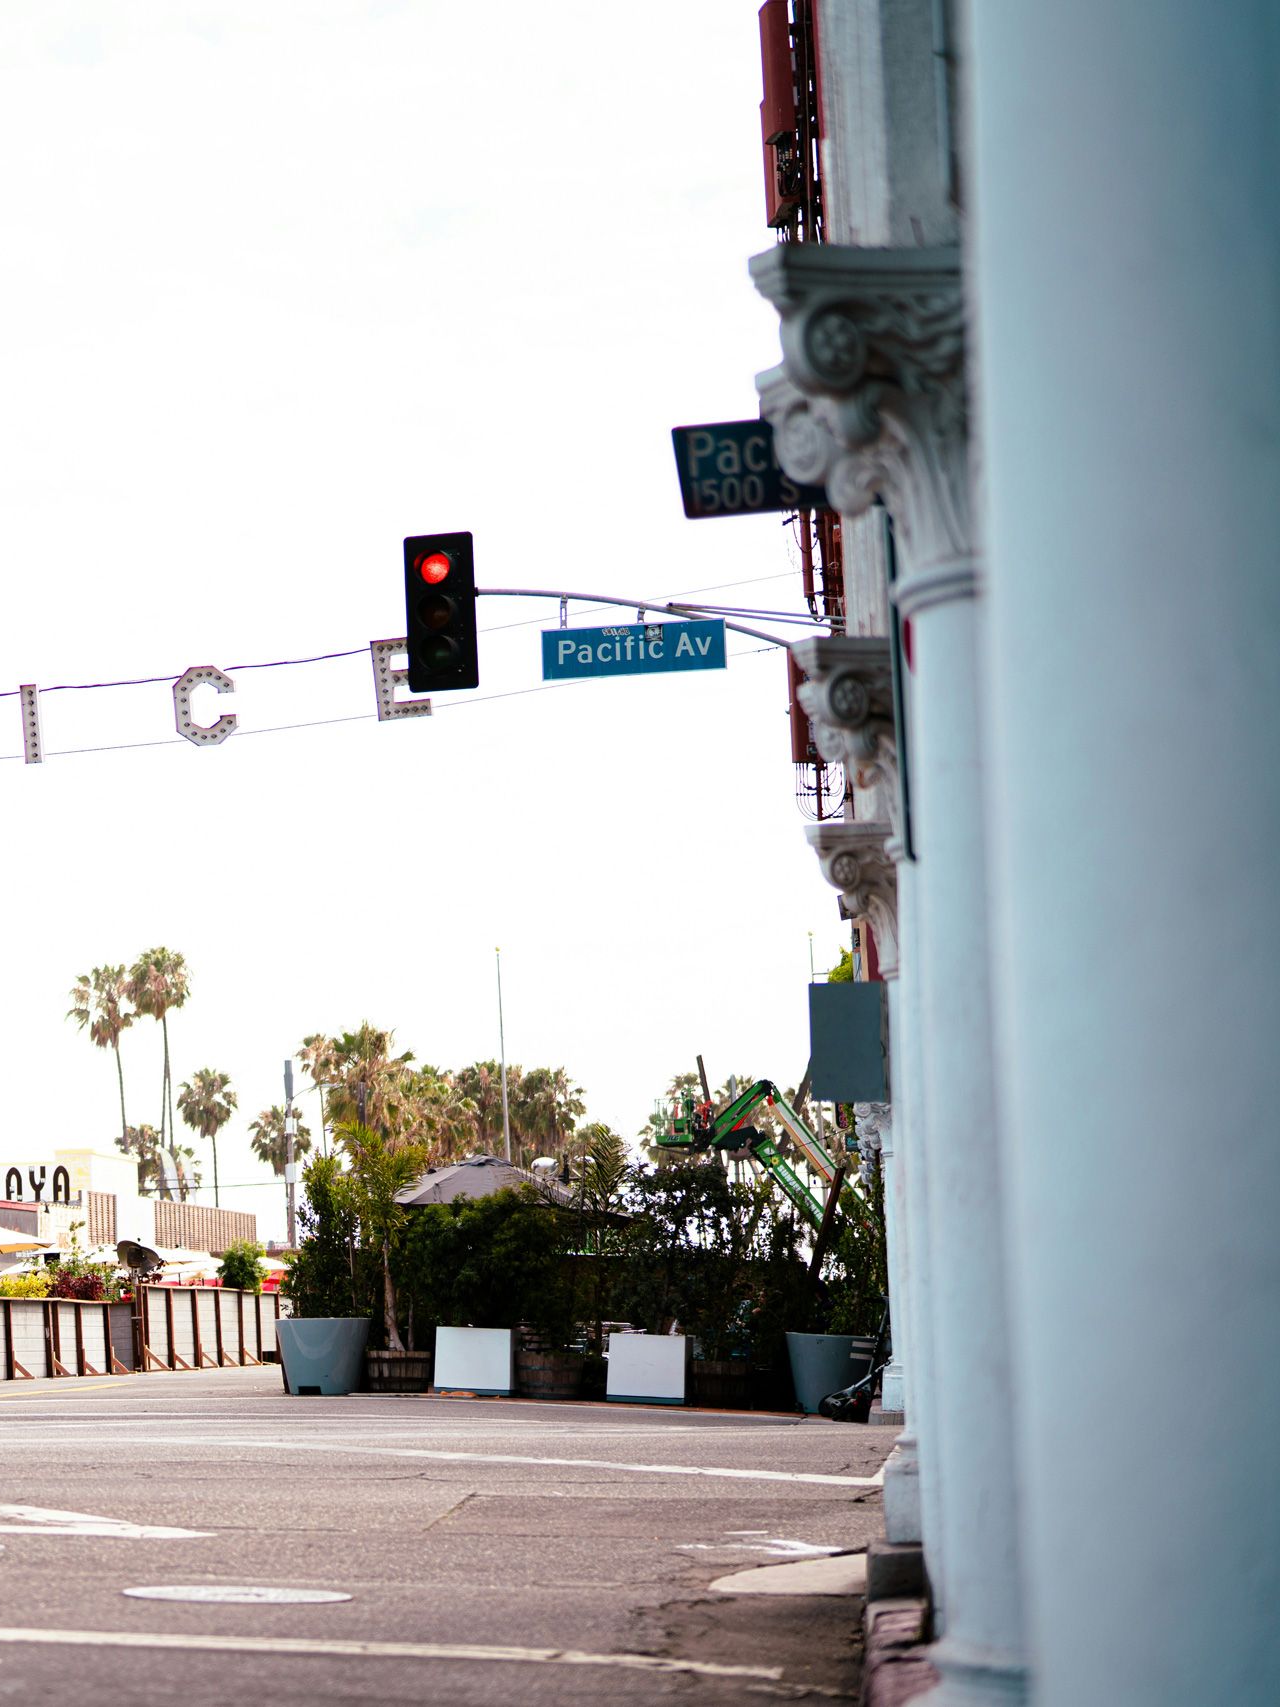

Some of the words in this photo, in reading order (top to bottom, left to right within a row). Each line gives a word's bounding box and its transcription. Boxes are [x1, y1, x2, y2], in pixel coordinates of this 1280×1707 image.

[687, 431, 768, 477] Pac
[691, 475, 763, 511] 1500
[557, 634, 664, 665] Pacific
[675, 632, 712, 657] Av
[5, 1165, 70, 1205] AYA
